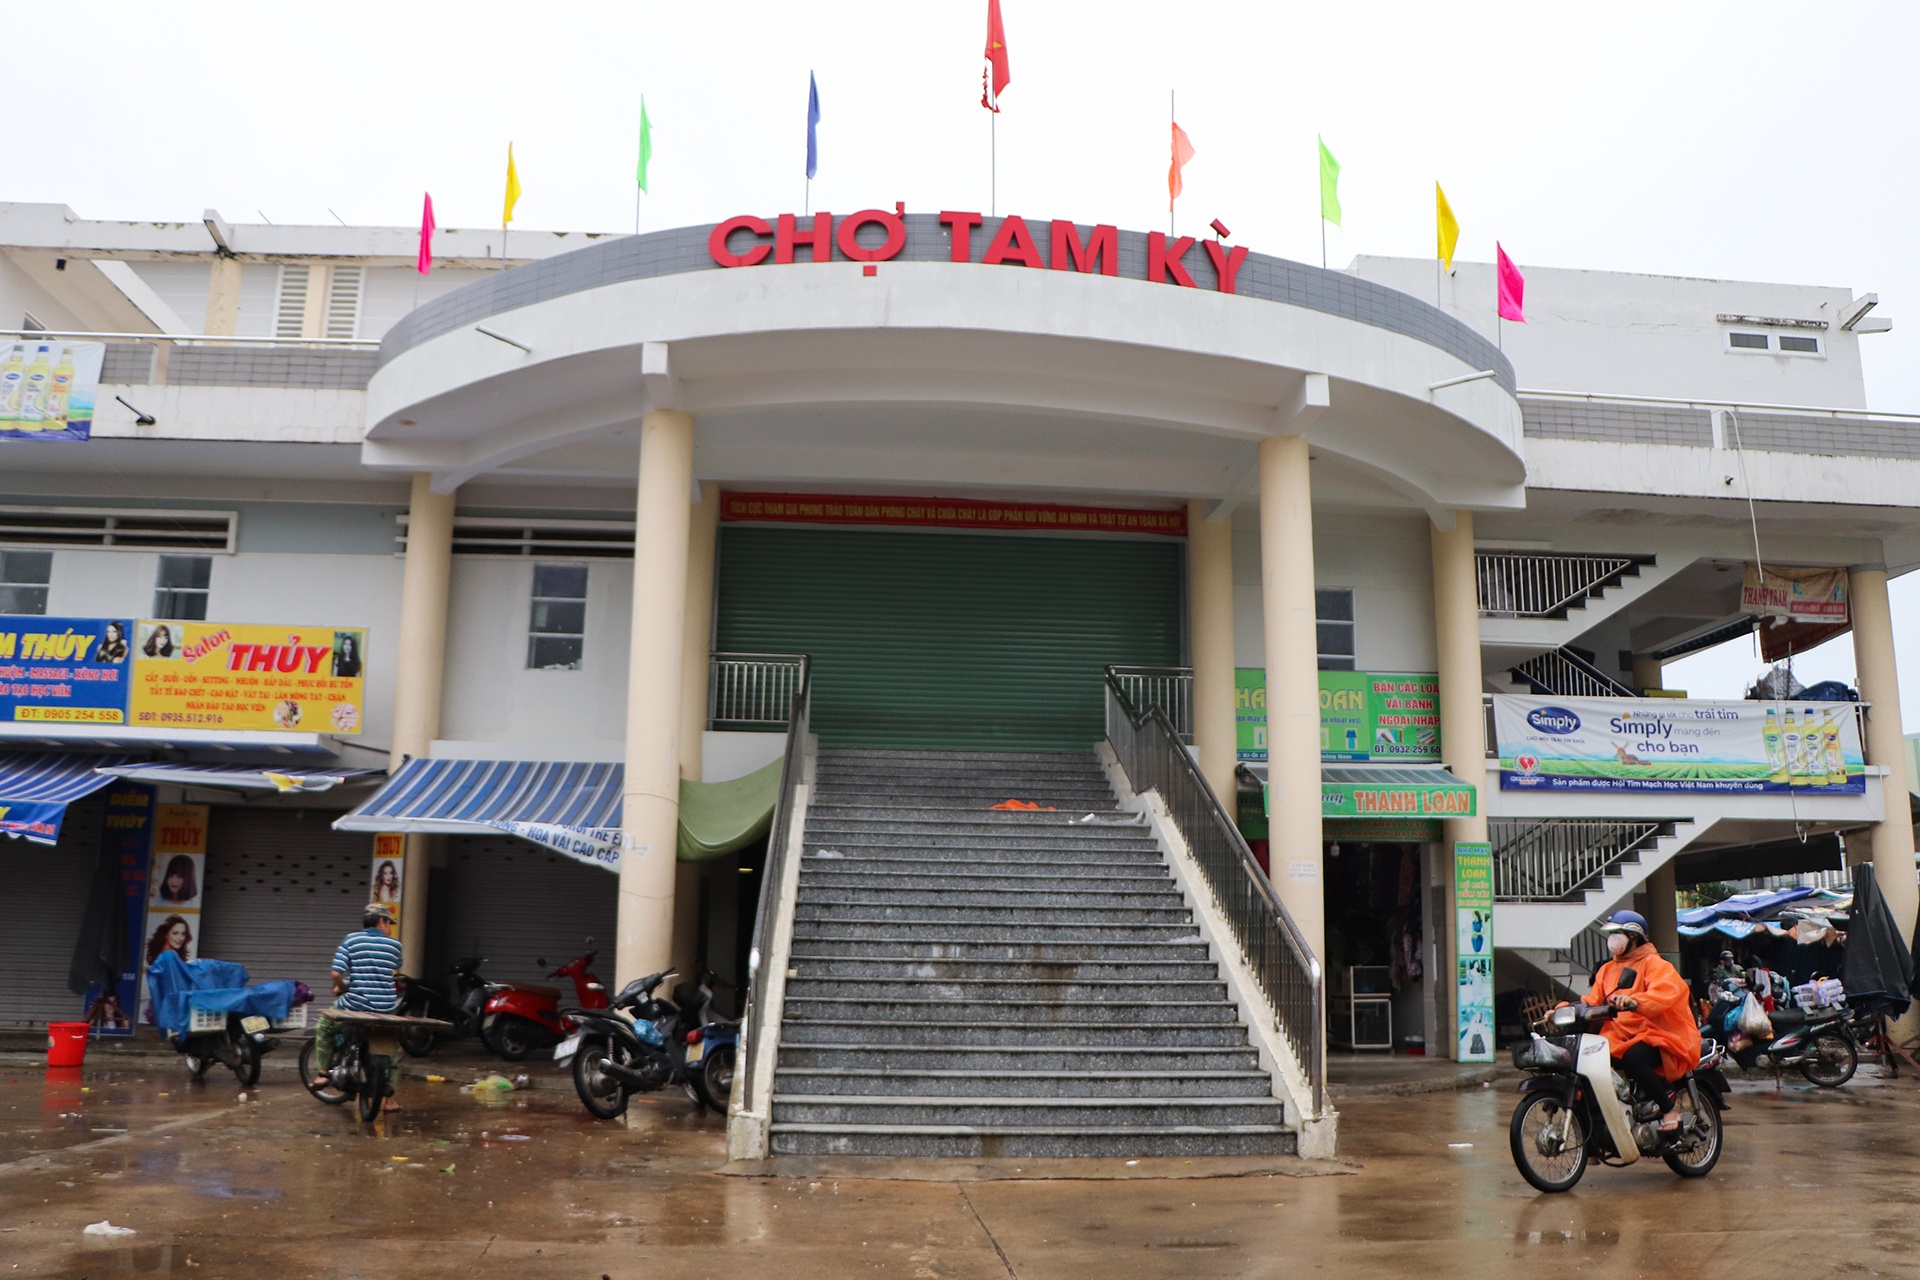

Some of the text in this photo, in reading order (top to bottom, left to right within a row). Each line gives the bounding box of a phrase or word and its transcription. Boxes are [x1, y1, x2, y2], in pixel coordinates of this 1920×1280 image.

[708, 201, 1249, 294] CHỢ TAM KỲ
[1058, 511, 1069, 523] AN
[1128, 514, 1137, 526] AN
[20, 627, 96, 662] THÚY
[181, 628, 231, 664] Salon
[227, 633, 331, 674] THỦY
[30, 666, 69, 680] MASSAGE
[1373, 680, 1395, 693] BÁN
[1397, 680, 1418, 693] CÁC
[1385, 695, 1402, 709] VẢI
[21, 708, 119, 720] ĐT: 0905 254 558
[1379, 713, 1440, 728] NGOẠI NHẬP
[1531, 710, 1577, 730] Simply
[1695, 708, 1715, 719] trái
[1717, 708, 1739, 719] tim
[1610, 711, 1721, 739] Simply mang đến
[1389, 744, 1411, 754] 0932
[1412, 745, 1429, 754] 259
[1637, 740, 1699, 756] cho bạn
[1552, 777, 1567, 786] Sản
[1591, 778, 1611, 788] được
[1612, 779, 1625, 788] Hội
[1642, 780, 1662, 789] Mạch
[1664, 781, 1678, 789] Học
[1679, 781, 1694, 789] Việt
[1715, 781, 1743, 790] khuyên
[1744, 781, 1764, 790] dùng
[1354, 789, 1418, 812] THANH
[1422, 789, 1471, 813] LOAN
[527, 826, 549, 844] HOA
[552, 831, 571, 850] VẢI
[572, 840, 595, 857] CAO
[596, 845, 620, 864] CẤP
[1457, 856, 1490, 867] THANH
[1461, 868, 1487, 879] LOAN
